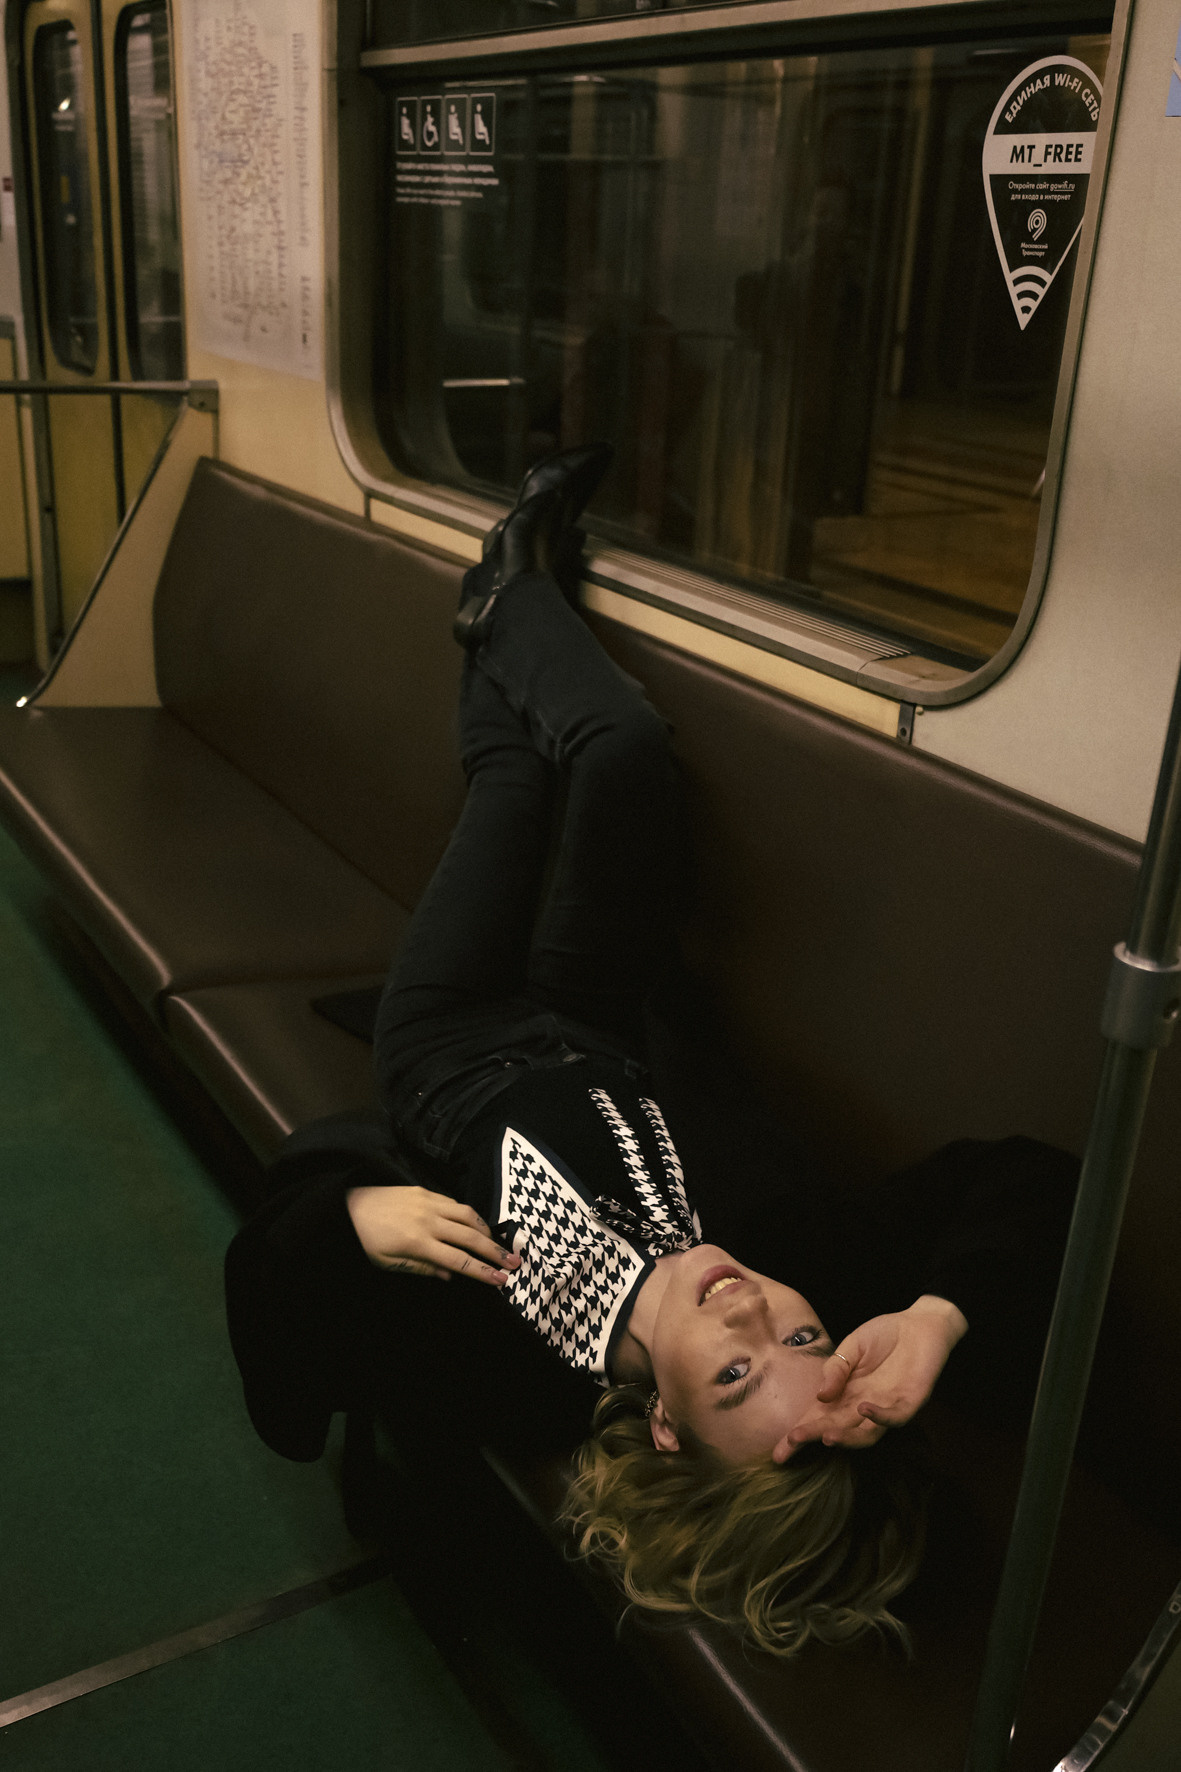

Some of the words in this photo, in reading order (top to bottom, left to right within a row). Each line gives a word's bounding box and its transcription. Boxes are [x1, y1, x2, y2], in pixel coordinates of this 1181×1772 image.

[1004, 74, 1051, 124] ЕДИНАЯ
[1054, 72, 1083, 93] WI-FI
[1081, 88, 1102, 122] СЕТЬ
[1009, 143, 1084, 167] MT_FREE
[1008, 181, 1035, 191] Откройте
[1036, 181, 1050, 190] сайт
[1050, 180, 1076, 192] gowifi.ru
[1044, 194, 1072, 202] интернет
